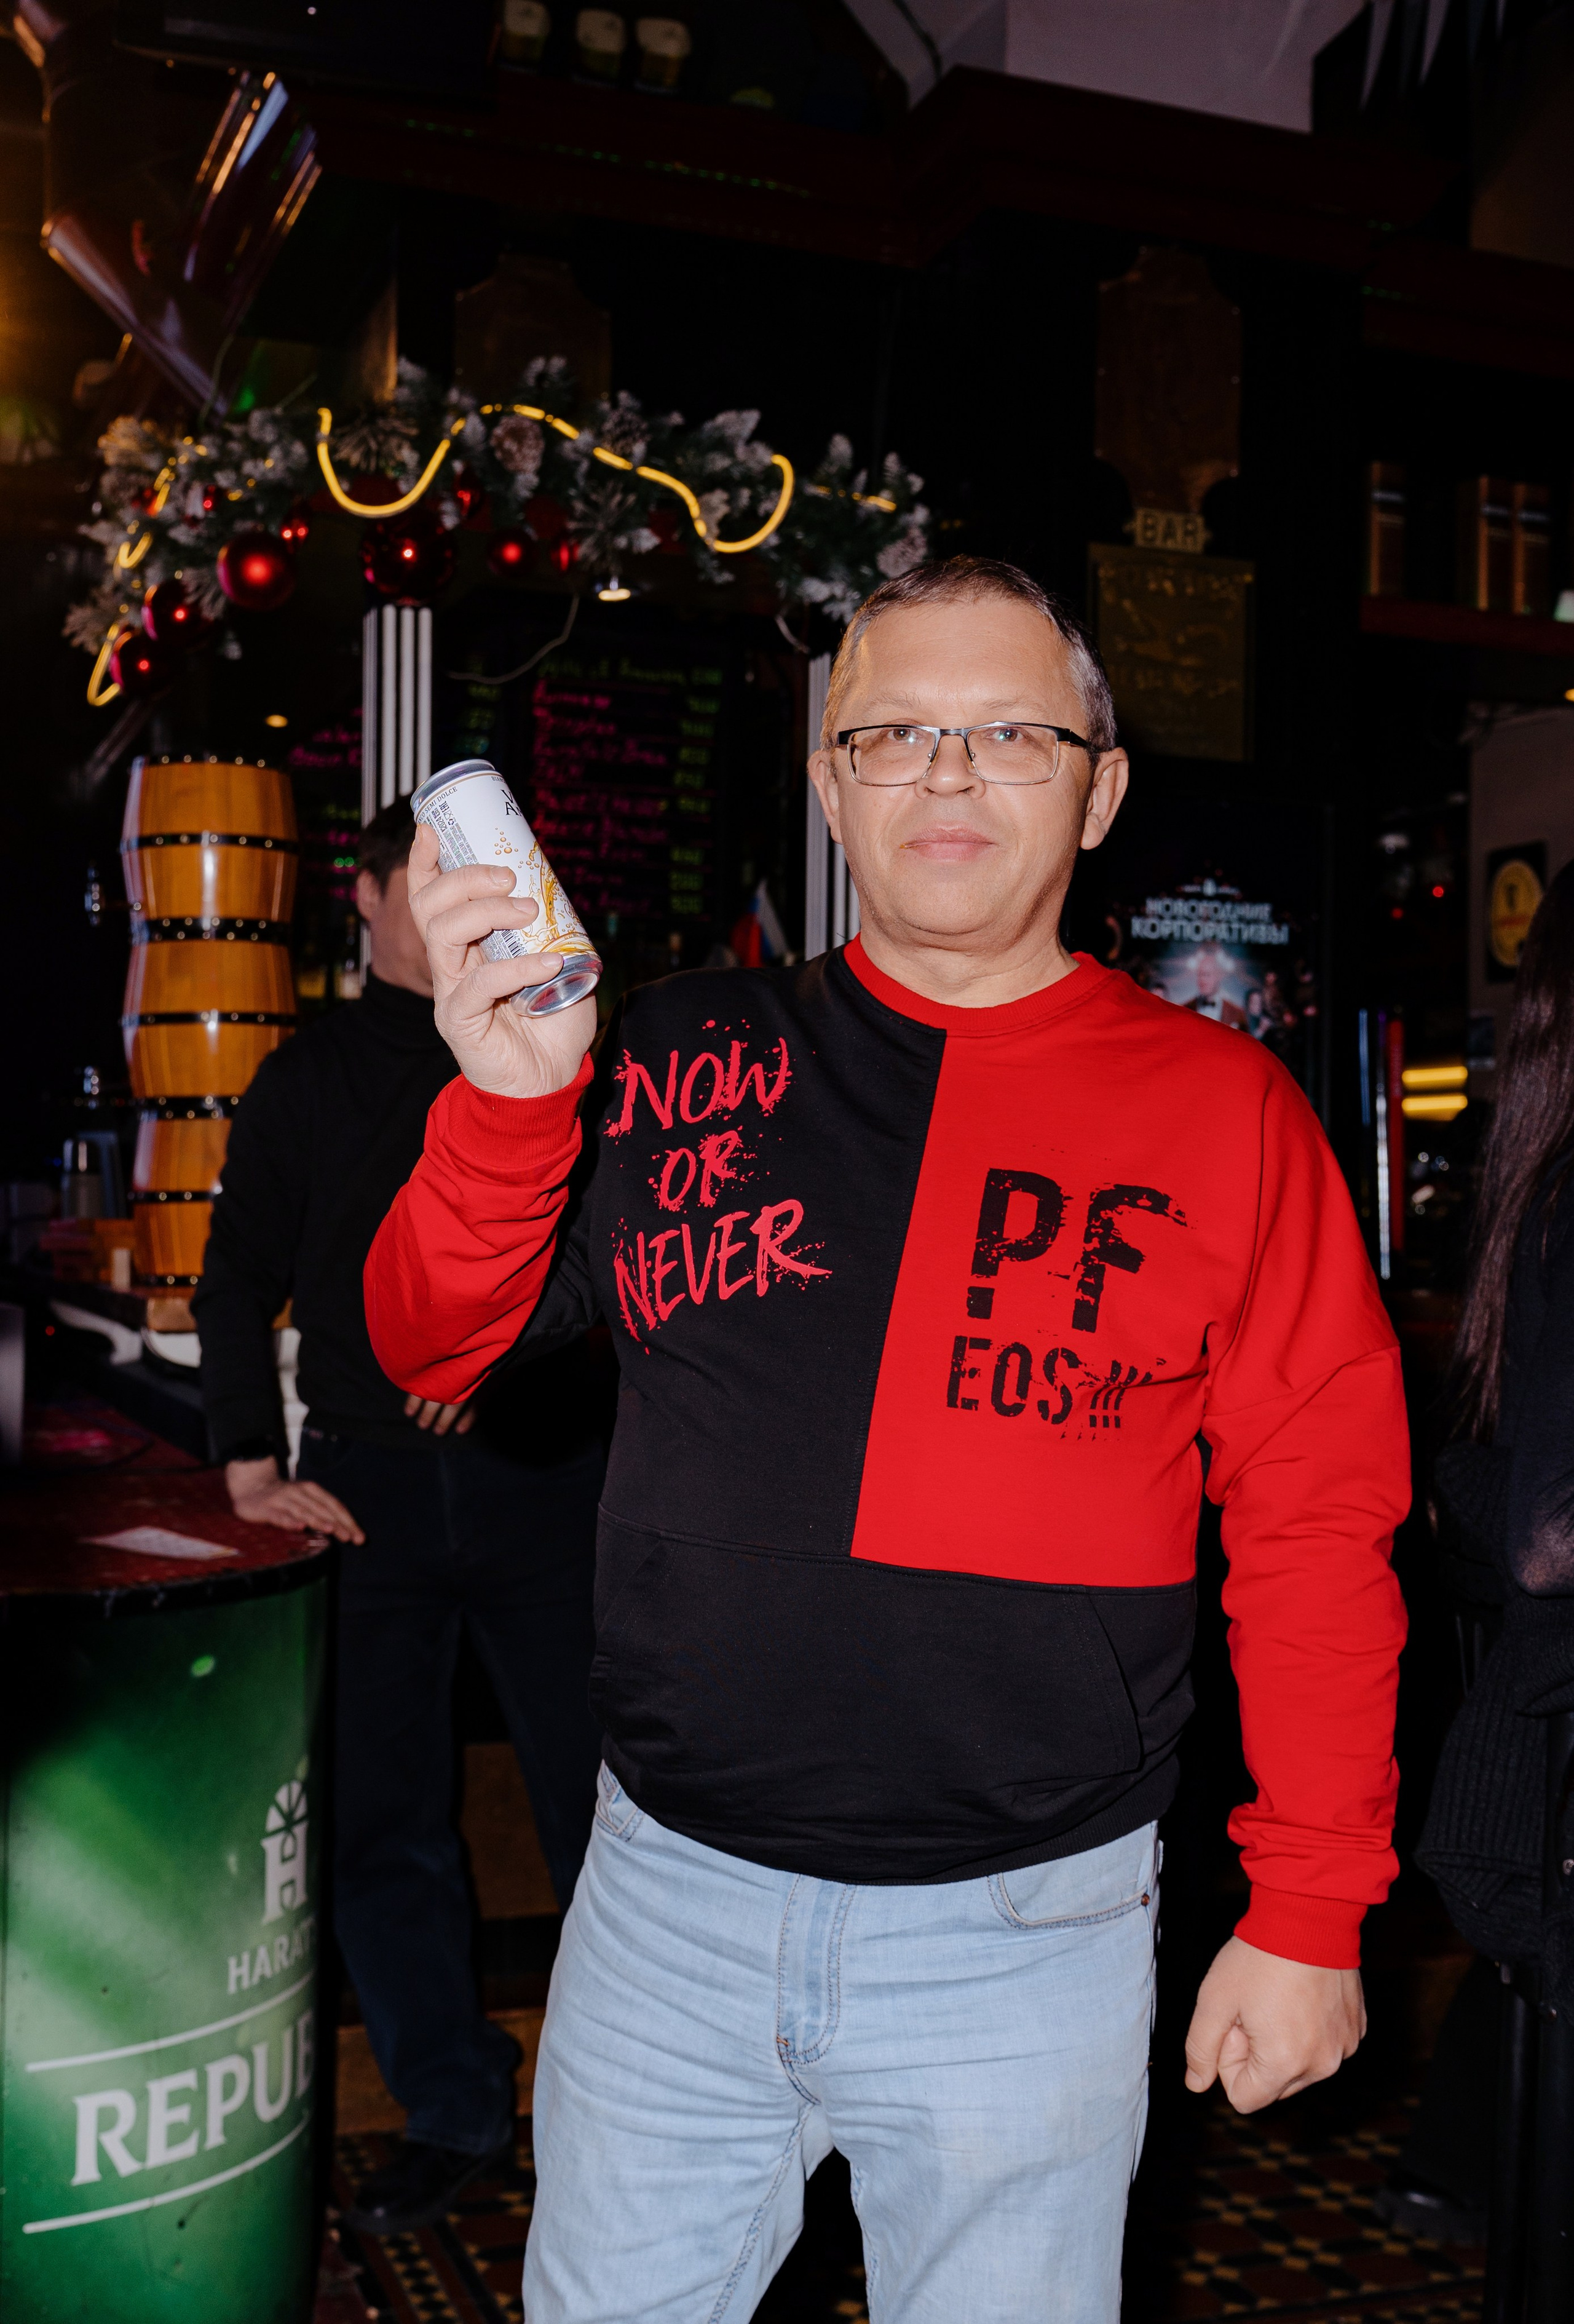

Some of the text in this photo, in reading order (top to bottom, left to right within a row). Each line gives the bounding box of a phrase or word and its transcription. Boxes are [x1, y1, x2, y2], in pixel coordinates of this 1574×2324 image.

[1142, 513, 1200, 549] BAR
[424, 799, 437, 814] SEMI
[437, 787, 457, 803] DOLCE
[1145, 896, 1273, 922] НОВОГОДНИЕ
[1130, 914, 1291, 946] КОРПОРАТИВЫ
[618, 1037, 792, 1135] NOW
[658, 1130, 739, 1210] OR
[614, 1199, 832, 1342] NEVER
